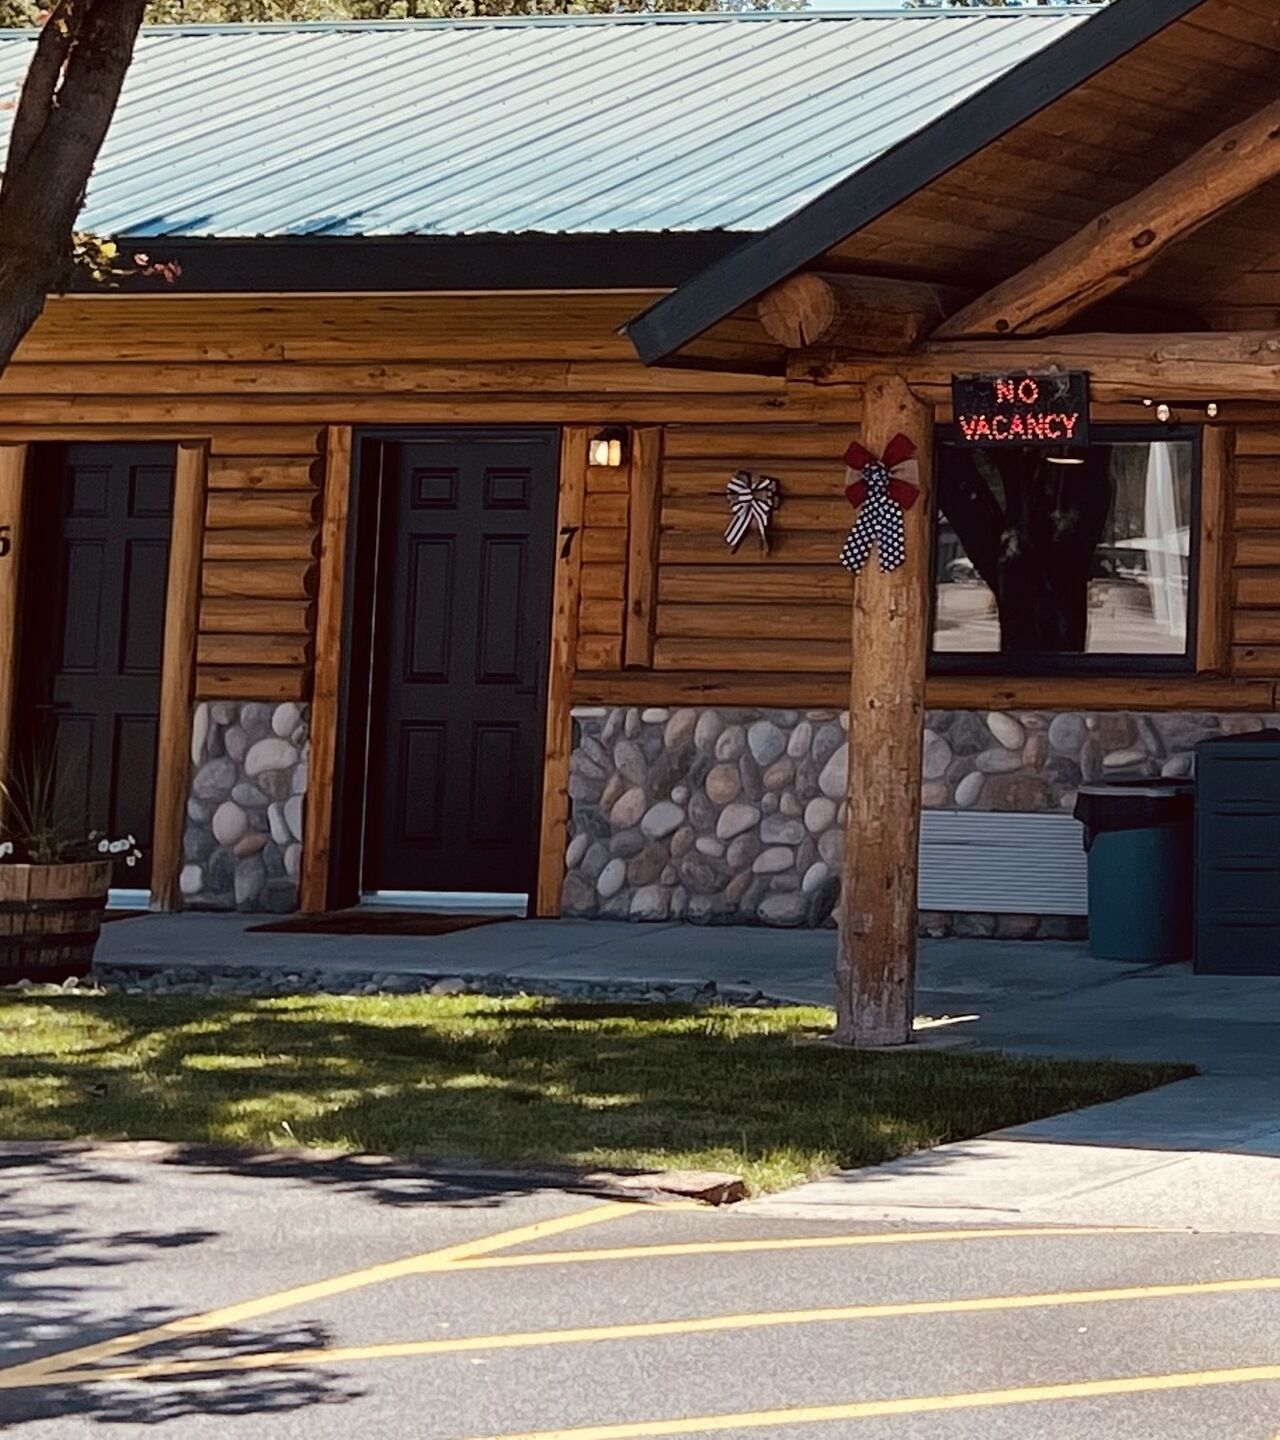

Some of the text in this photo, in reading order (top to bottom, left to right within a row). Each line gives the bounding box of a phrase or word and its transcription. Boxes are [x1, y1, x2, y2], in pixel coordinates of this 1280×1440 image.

[994, 378, 1039, 403] NO
[959, 412, 1079, 440] VACANCY
[560, 526, 579, 559] 7
